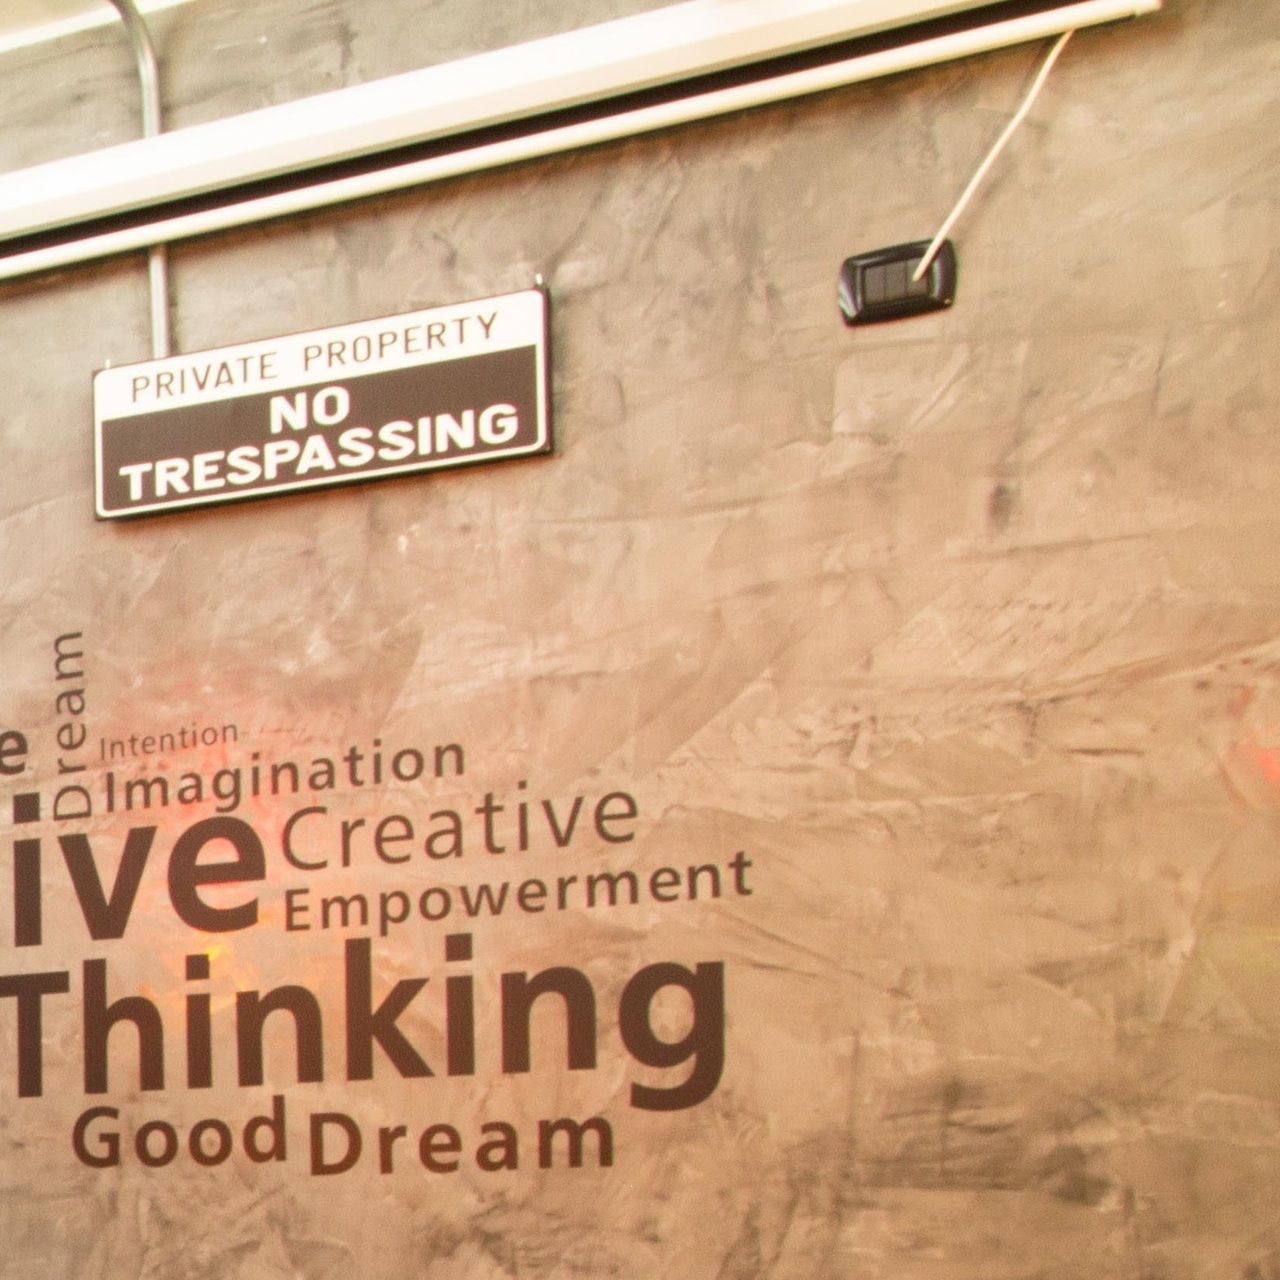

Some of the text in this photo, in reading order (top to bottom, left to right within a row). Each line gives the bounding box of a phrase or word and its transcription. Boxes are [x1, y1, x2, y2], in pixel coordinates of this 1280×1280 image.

[131, 311, 498, 404] PRIVATE PROPERTY
[118, 404, 519, 501] TRESPASSING
[269, 386, 350, 434] NO
[52, 631, 92, 822] Dream
[100, 721, 239, 761] Intention
[106, 739, 465, 814] Imagination
[282, 781, 639, 871] Creative
[284, 850, 754, 936] Empowerment
[72, 1095, 614, 1176] Good Dream
